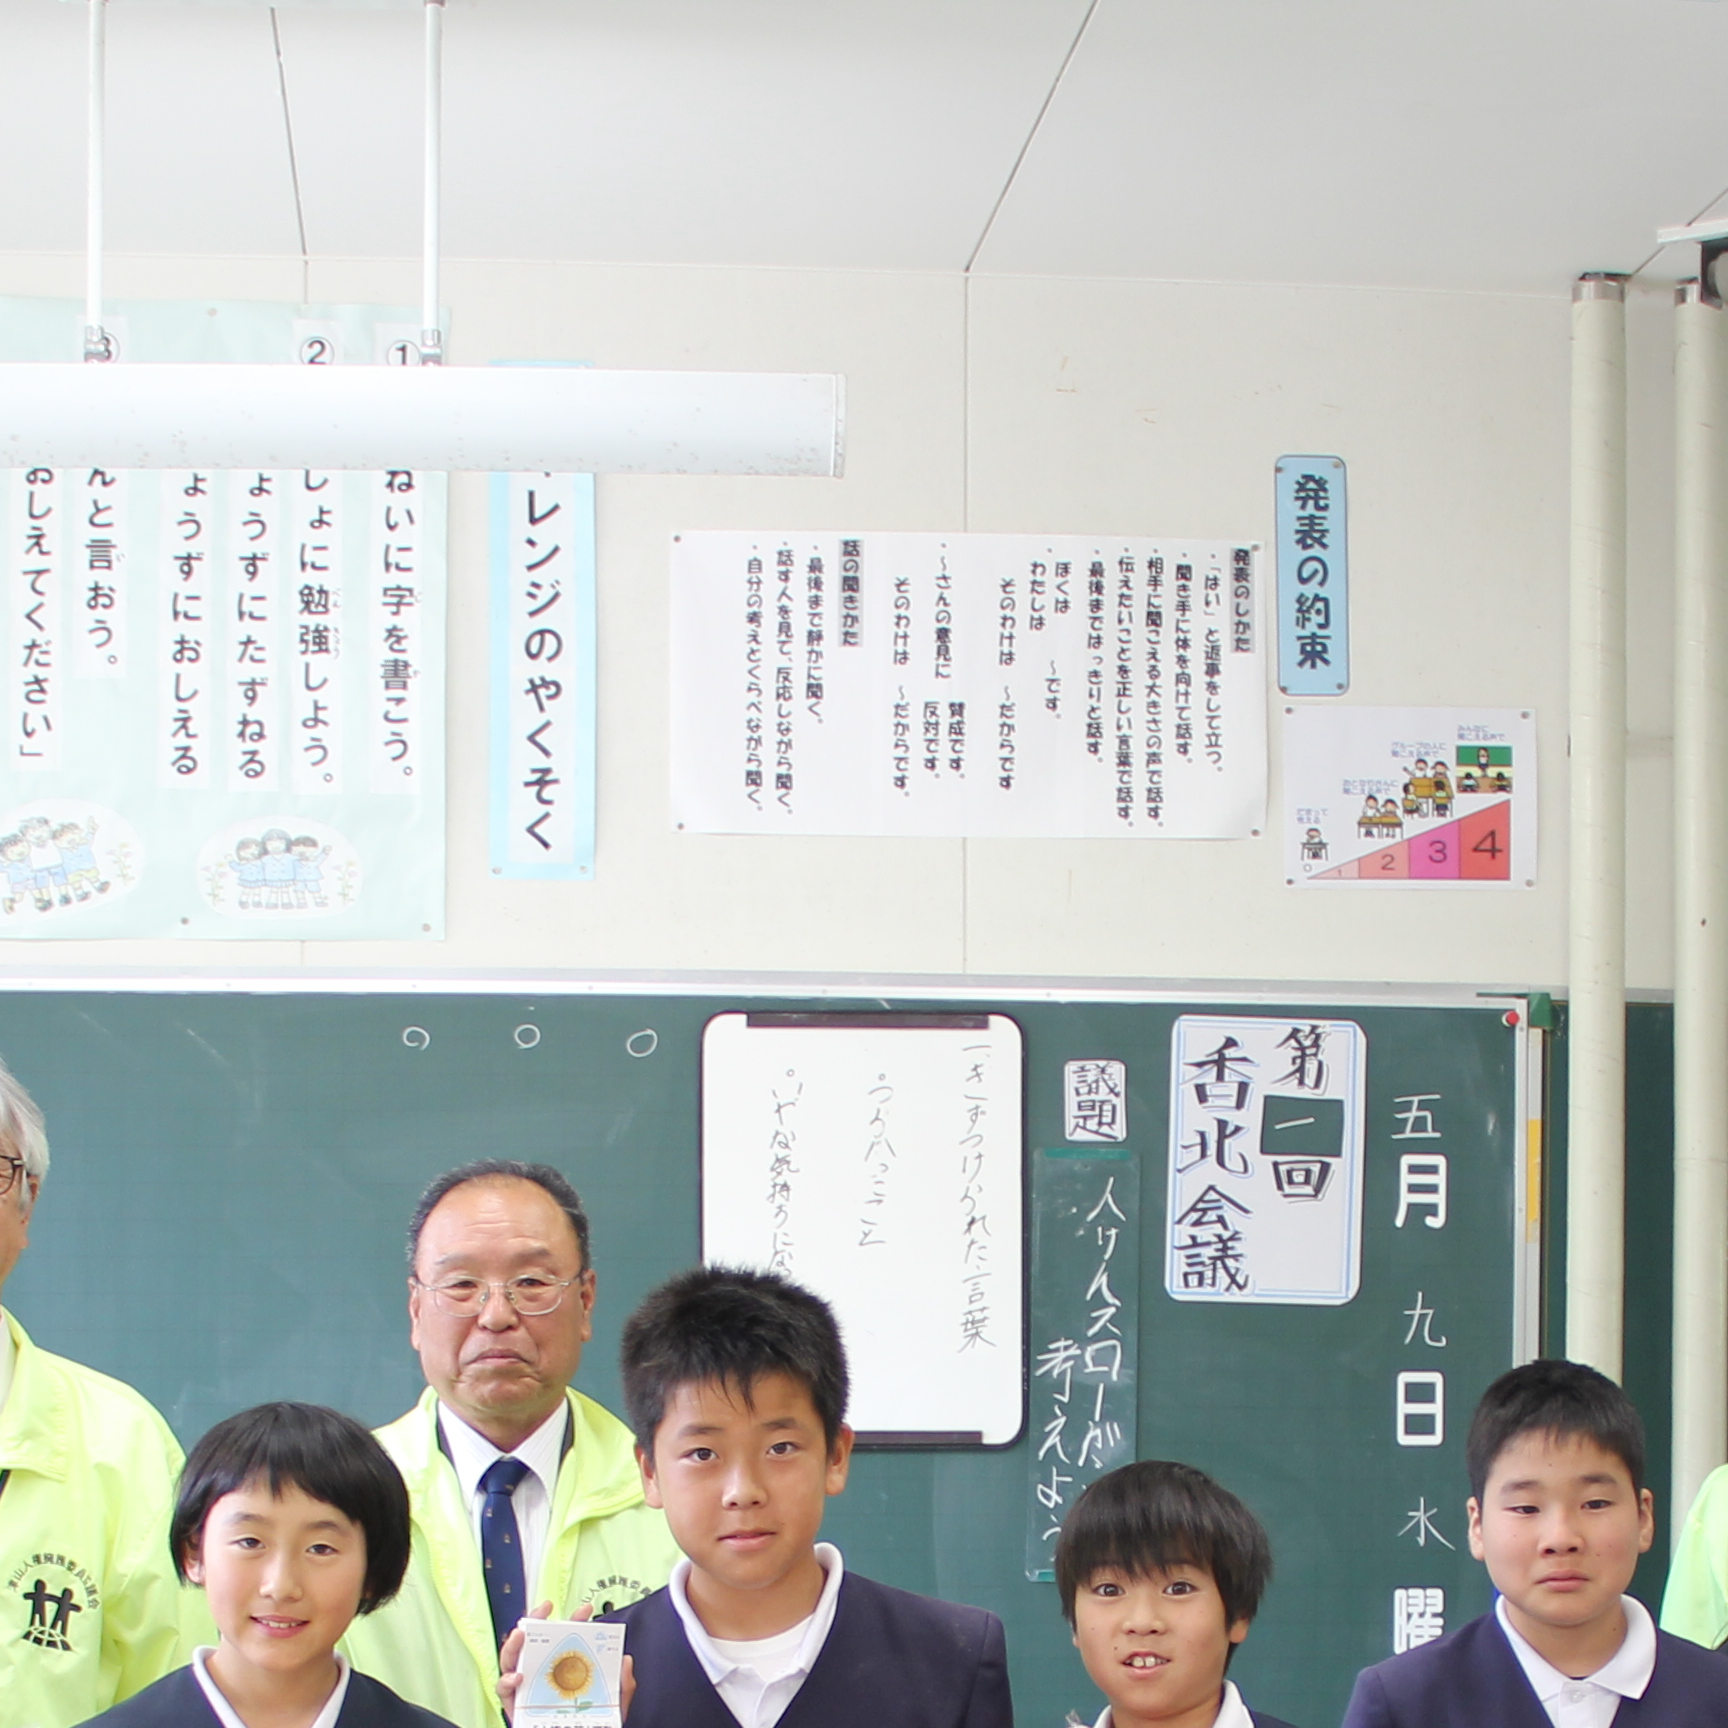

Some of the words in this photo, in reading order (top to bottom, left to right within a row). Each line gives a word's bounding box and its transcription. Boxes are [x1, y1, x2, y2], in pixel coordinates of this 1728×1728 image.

[841, 539, 861, 647] 話の聞きかた
[1233, 548, 1252, 653] 発表のしかた
[1293, 474, 1332, 670] 発表の約束
[523, 472, 564, 851] レンジのやくそく
[893, 576, 911, 667] そのわけは
[999, 576, 1016, 667] そのわけは
[1380, 854, 1396, 871] 2
[1428, 840, 1448, 864] 3
[1472, 829, 1503, 860] 4
[1071, 1061, 1121, 1140] 議題
[1174, 1035, 1256, 1294] 香北会議
